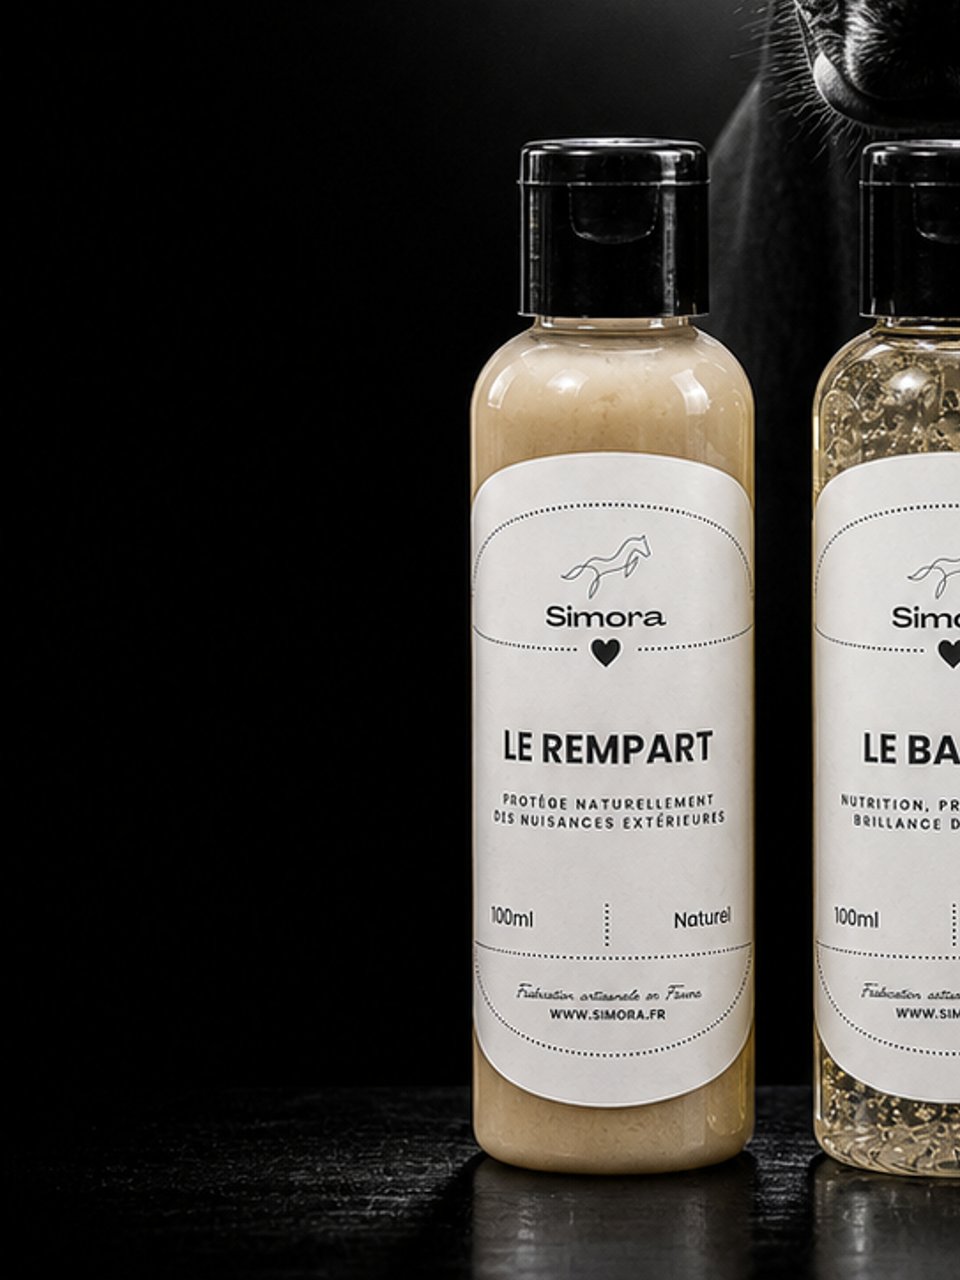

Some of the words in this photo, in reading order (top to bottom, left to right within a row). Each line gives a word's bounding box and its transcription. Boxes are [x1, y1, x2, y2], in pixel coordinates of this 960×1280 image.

[546, 605, 666, 627] Simora
[504, 730, 532, 762] LE
[543, 730, 713, 764] REMPART
[864, 733, 896, 764] LE
[842, 794, 929, 812] NUTRITION,
[521, 814, 614, 829] NUISANCES
[854, 814, 940, 830] BRILLANCE
[491, 906, 533, 928] 100ml
[675, 906, 731, 928] Naturel
[835, 907, 878, 928] 100ml
[550, 1009, 665, 1020] WWW.SIMORA.FR
